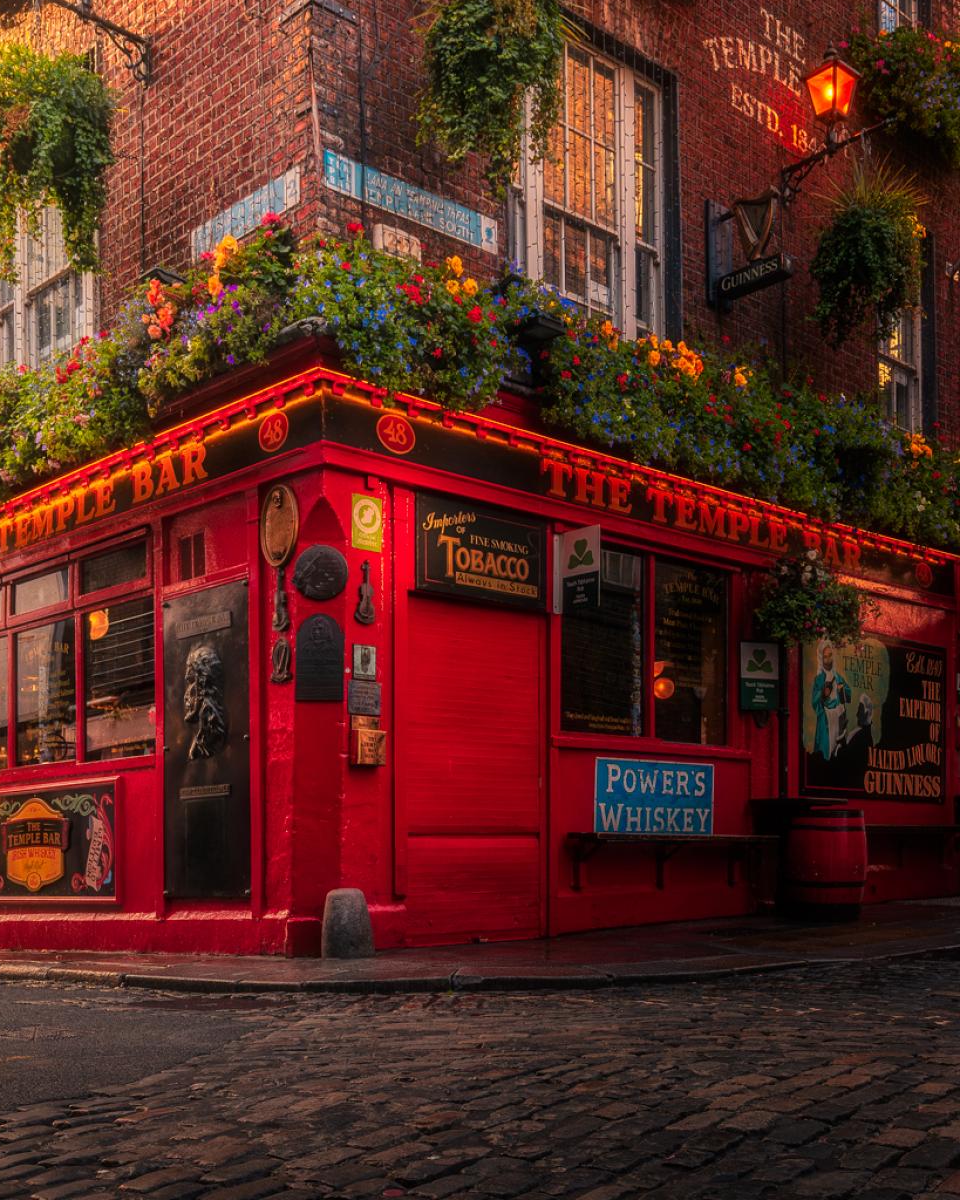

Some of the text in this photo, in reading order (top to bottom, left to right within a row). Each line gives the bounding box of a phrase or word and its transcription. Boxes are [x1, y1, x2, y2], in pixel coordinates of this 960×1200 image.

[760, 6, 807, 65] THE
[702, 36, 802, 97] TEMPLE
[731, 82, 784, 137] ESTD.
[721, 260, 779, 292] GUINNESS
[263, 419, 284, 446] 48
[383, 419, 408, 446] 48
[131, 442, 210, 503] BAR
[422, 510, 477, 535] Importers
[542, 457, 863, 568] THE TEMPLE BAR
[436, 533, 530, 582] TOBACCO
[470, 534, 530, 556] FINE SMOKING
[456, 572, 491, 588] Always
[509, 581, 538, 596] Stock
[853, 643, 874, 660] THE
[842, 655, 883, 678] TEMPLE
[852, 672, 875, 692] BAR
[921, 679, 941, 700] THE
[899, 696, 941, 723] EMPEROR
[929, 722, 941, 743] OF
[867, 742, 943, 771] MALTED LIQUORS
[605, 763, 707, 797] POWER'S
[863, 770, 941, 798] GUINNESS
[26, 822, 41, 832] THE
[598, 802, 711, 833] WHISKEY
[7, 832, 62, 847] TEMPLE BAR
